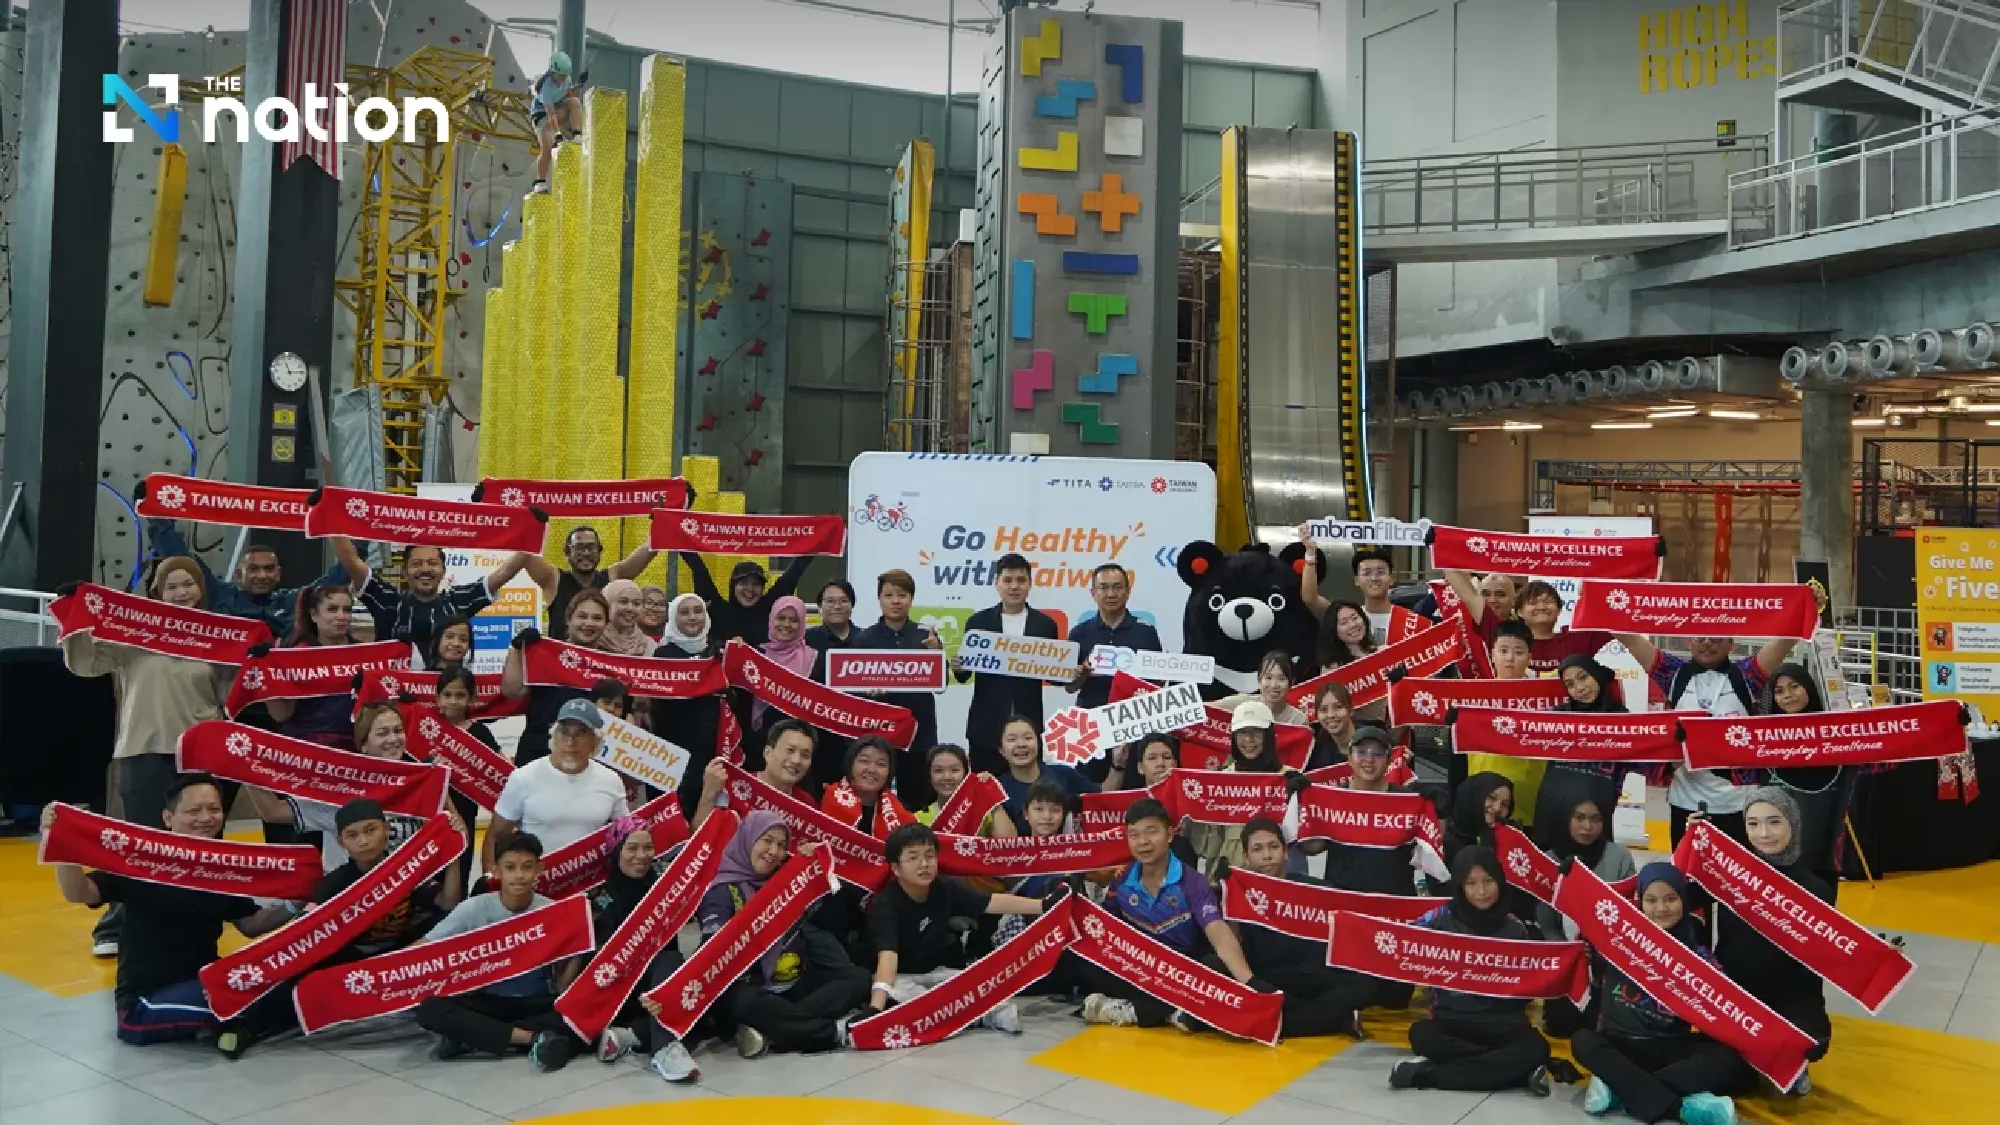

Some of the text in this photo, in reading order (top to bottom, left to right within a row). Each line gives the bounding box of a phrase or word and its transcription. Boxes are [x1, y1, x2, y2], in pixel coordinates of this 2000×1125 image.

[1637, 0, 1748, 53] HIGH
[1639, 35, 1793, 94] ROPES
[529, 490, 667, 505] TAIWAN EXCELLENCE
[1063, 479, 1092, 488] TITA
[190, 493, 255, 512] TAIWAN
[374, 504, 510, 527] TAIWAN EXCELLENCE
[703, 523, 815, 537] TAIWAN EXCELLENCE
[942, 525, 1129, 560] Go Healthy
[446, 554, 469, 567] ith
[1491, 540, 1624, 557] TAIWAN EXCELLENCE
[1929, 555, 1995, 570] Give Me
[1554, 580, 1575, 592] ith
[1634, 595, 1784, 610] TAIWAN EXCELLENCE
[106, 603, 248, 642] TAIWAN EXCELLENCE
[472, 624, 489, 634] Aug
[965, 633, 1071, 662] Go Healthy
[1141, 655, 1210, 673] BioGend
[268, 664, 330, 681] TAIWAN
[629, 667, 701, 682] EXCELLENCE
[837, 660, 935, 678] JOHNSON
[959, 653, 1074, 678] with Taiwan
[762, 675, 896, 732] TAIWAN EXCELLENCE
[1102, 684, 1198, 727] TAIWAN
[1112, 707, 1204, 743] EXCELLENCE
[1519, 719, 1668, 735] TAIWAN EXCELLENCE
[1754, 718, 1920, 742] TAIWAN EXCELLENCE
[442, 732, 485, 770] TAIWAN
[605, 721, 681, 768] Healthy
[256, 743, 406, 788] TAIWAN EXCELLENCE
[612, 746, 677, 789] Taiwan
[1207, 784, 1261, 798] TAIWAN
[1308, 803, 1369, 827] TAIWAN
[134, 837, 296, 872] TAIWAN EXCELLENCE
[804, 823, 887, 867] EXCELLENCE
[982, 829, 1124, 851] TAIWAN EXCELLENCE
[542, 847, 599, 880] TAIWAN
[264, 839, 440, 972] TAIWAN EXCELLENCE
[613, 914, 654, 964] TAIWAN
[653, 842, 713, 919] EXCELLENCE
[1710, 843, 1859, 956] TAIWAN EXCELLENCE
[701, 928, 752, 983] TAIWAN
[752, 859, 824, 930] EXCELLENCE
[377, 923, 547, 984] TAIWAN EXCELLENCE
[1105, 930, 1244, 1010] TAIWAN EXCELLENCE
[1401, 939, 1561, 972] TAIWAN EXCELLENCE
[913, 924, 1066, 1036] TAIWAN EXCELLENCE
[1619, 918, 1676, 973] TAIWAN
[1671, 962, 1765, 1039] EXCELLENCE
